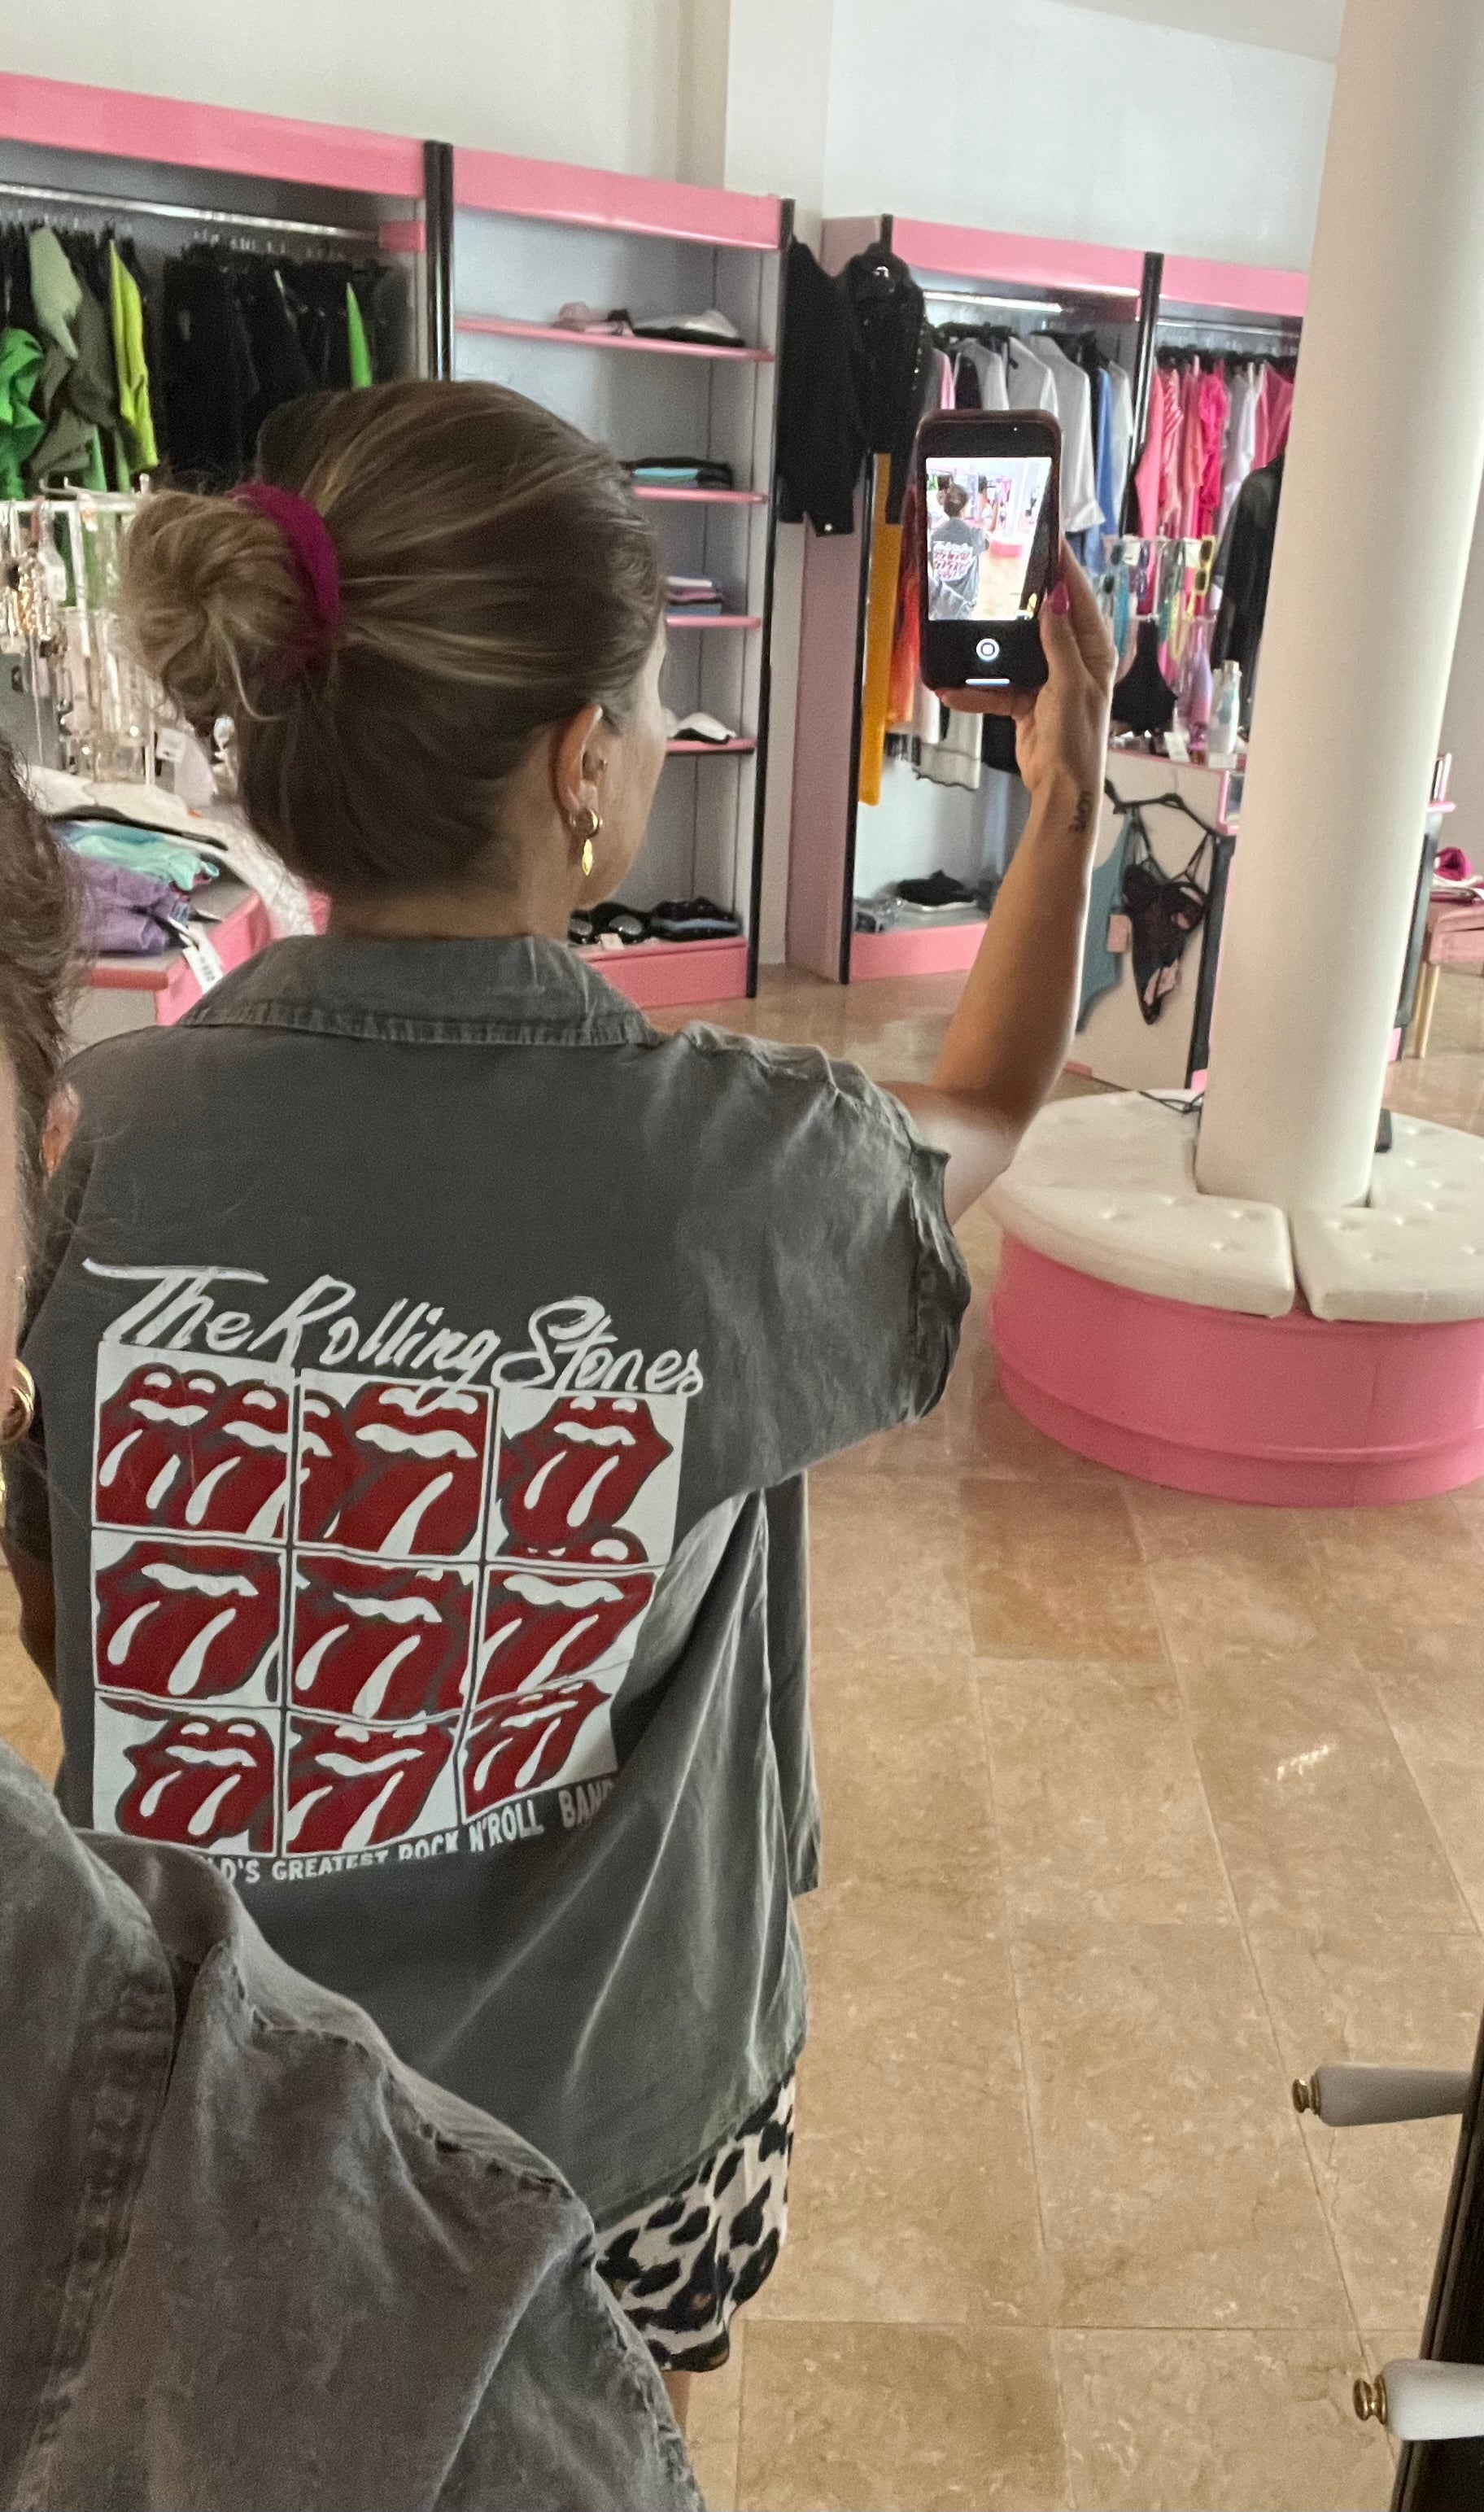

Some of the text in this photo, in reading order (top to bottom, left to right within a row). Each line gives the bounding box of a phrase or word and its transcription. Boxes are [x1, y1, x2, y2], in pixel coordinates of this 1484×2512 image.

[82, 1257, 703, 1417] The Rolling Stones
[207, 1857, 260, 1884] D'S
[271, 1849, 389, 1881] GREATEST
[398, 1829, 459, 1861] ROCK
